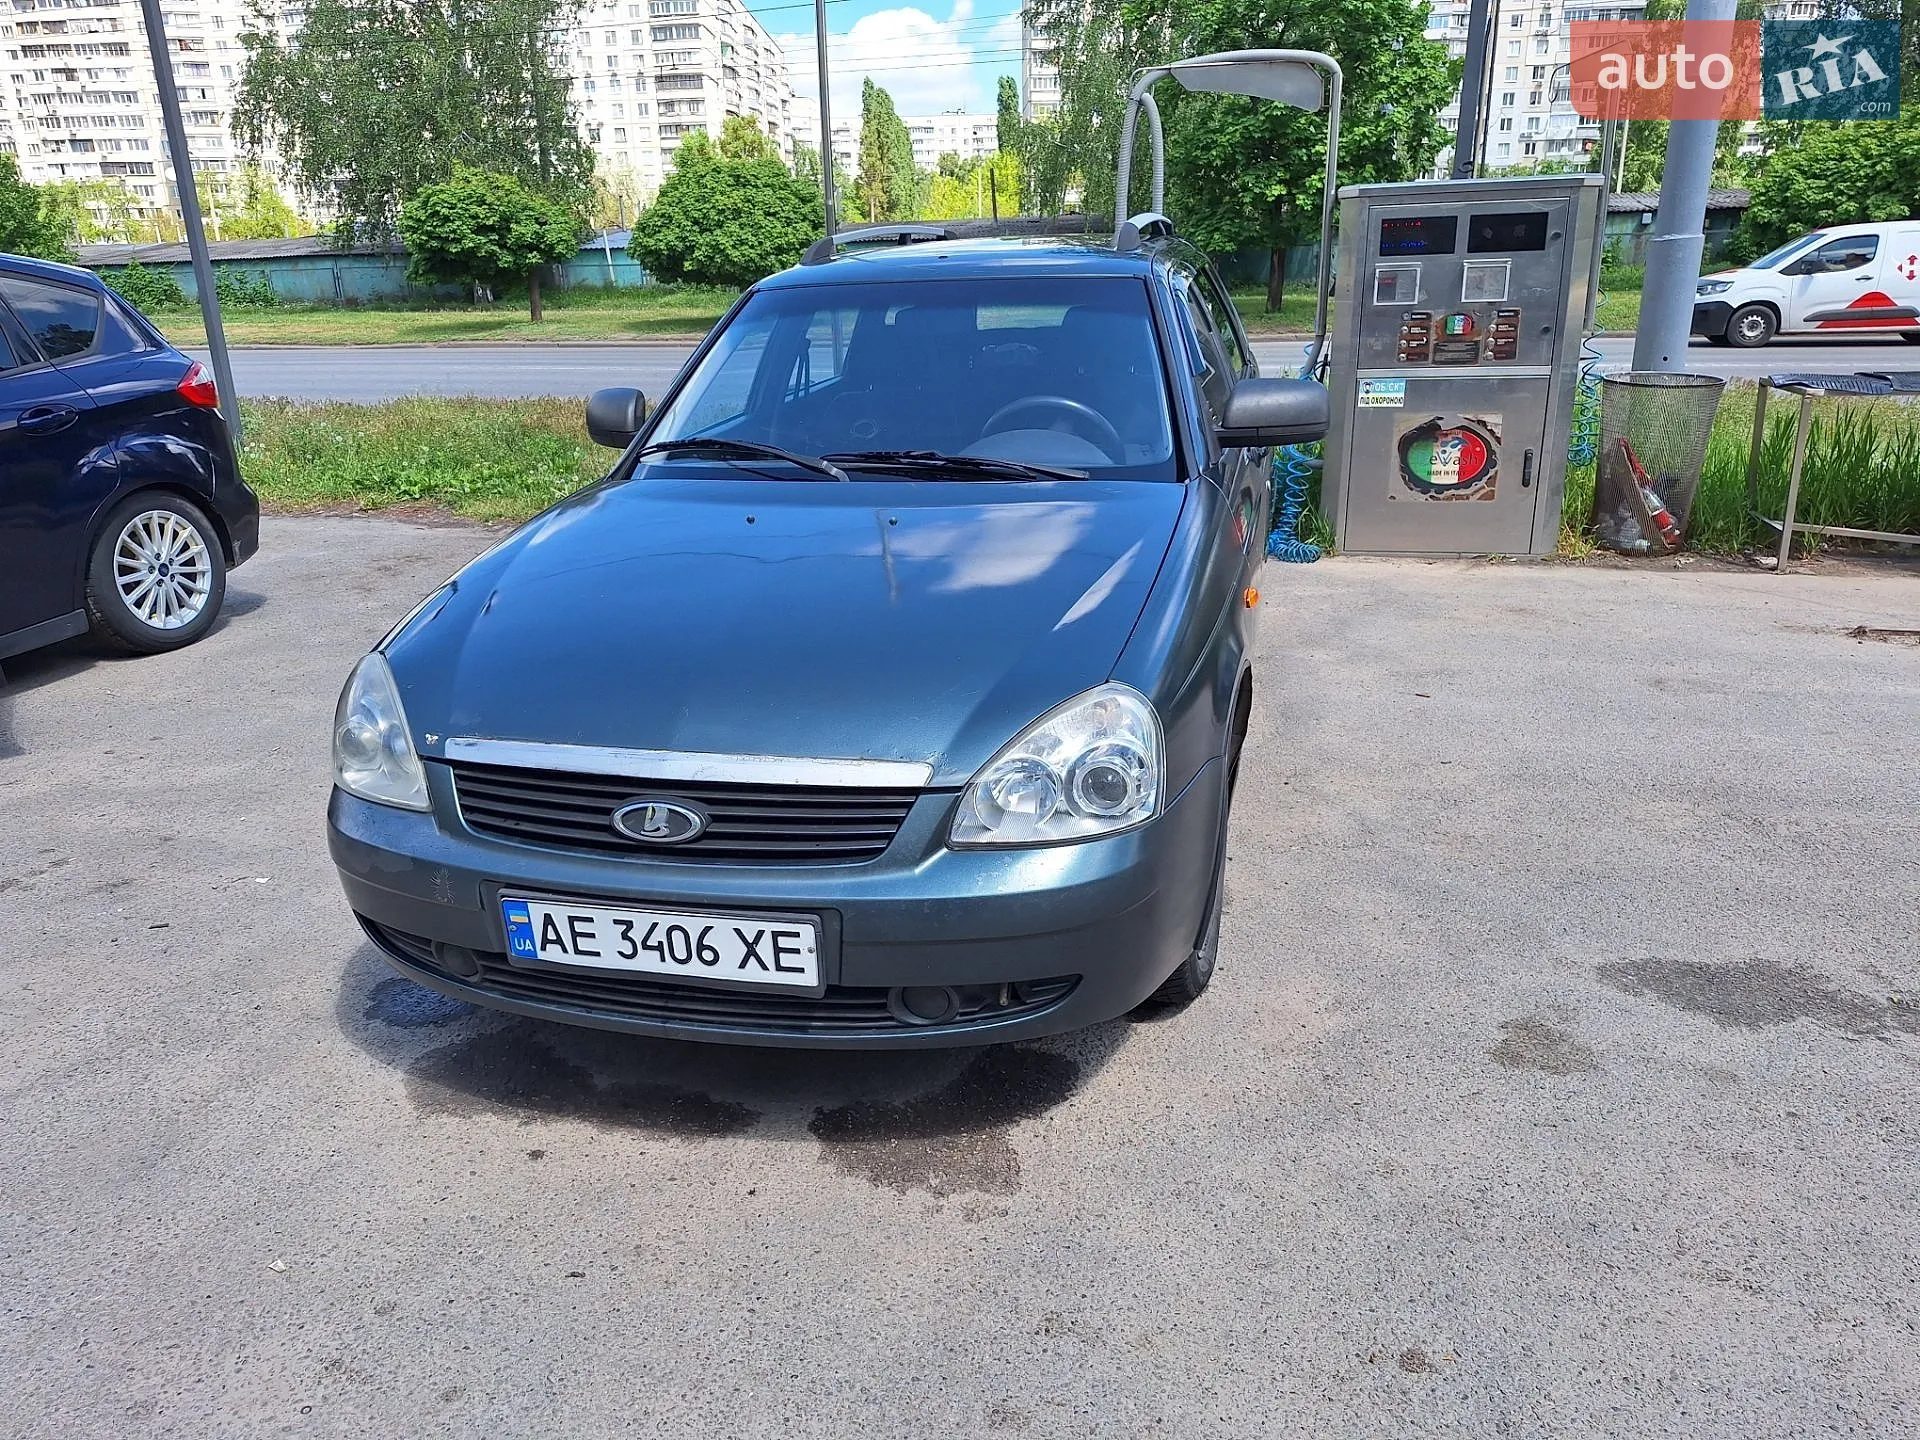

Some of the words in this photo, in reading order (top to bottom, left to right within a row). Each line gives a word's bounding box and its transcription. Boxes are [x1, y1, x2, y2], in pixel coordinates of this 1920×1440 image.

[515, 938, 534, 952] UA
[540, 912, 602, 957] AE
[612, 918, 720, 967] 3406
[733, 927, 805, 974] XE
